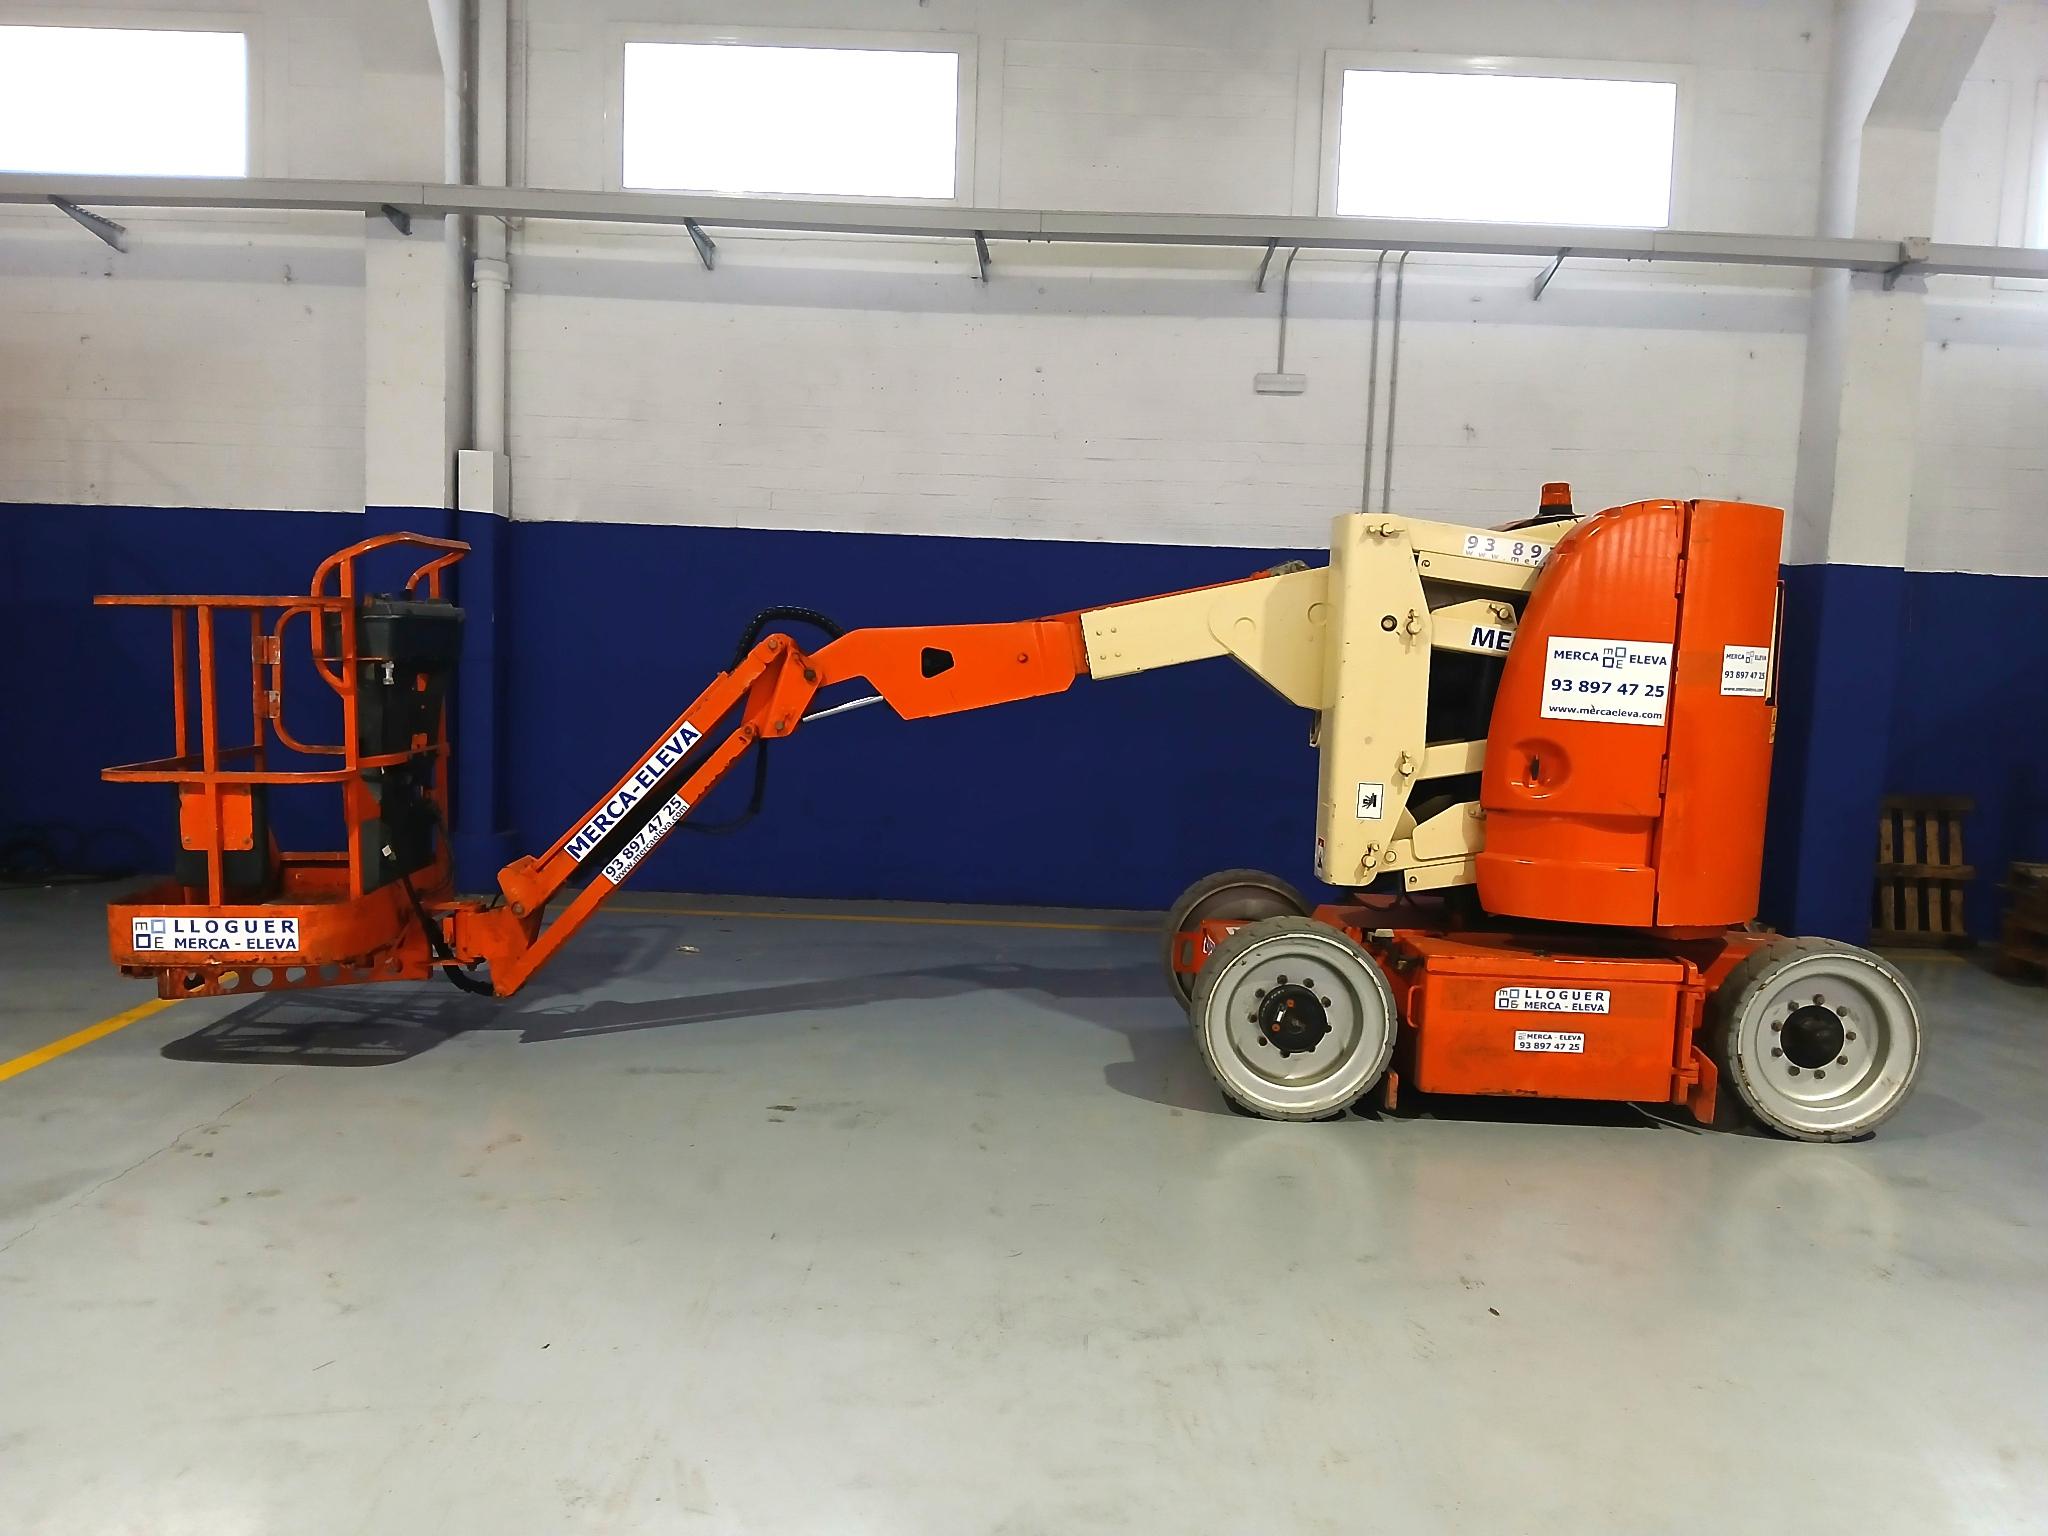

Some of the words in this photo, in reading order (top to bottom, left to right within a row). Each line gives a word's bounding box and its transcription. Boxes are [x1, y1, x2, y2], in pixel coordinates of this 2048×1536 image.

[1467, 535, 1496, 552] 93
[1512, 542, 1554, 559] 89
[1471, 627, 1517, 651] ME
[1553, 650, 1599, 661] MERCA
[1629, 654, 1667, 666] ELEVA
[1724, 670, 1734, 679] 93
[1735, 670, 1749, 680] 897
[1750, 671, 1758, 680] 47
[1551, 678, 1573, 692] 93
[1578, 680, 1612, 694] 897
[1617, 683, 1639, 696] 47
[1644, 684, 1665, 698] 25
[1549, 705, 1662, 719] www.mercaeleva.com
[566, 728, 699, 860] MERCA-ELEVA
[605, 857, 624, 878] 93
[622, 832, 647, 861] 897
[647, 814, 664, 835] 47
[662, 796, 683, 817] 25
[613, 804, 688, 883] www.mercaeleva.com
[174, 919, 296, 934] LLOGUER
[174, 938, 230, 950] MERCA
[246, 938, 297, 950] ELEVA
[1524, 989, 1605, 1002] LLOGUER
[1524, 1001, 1562, 1011] MERCA
[1571, 1003, 1605, 1012] ELEVA
[1519, 1041, 1531, 1049] 93
[1533, 1042, 1551, 1050] 897
[1568, 1043, 1580, 1051] 25
